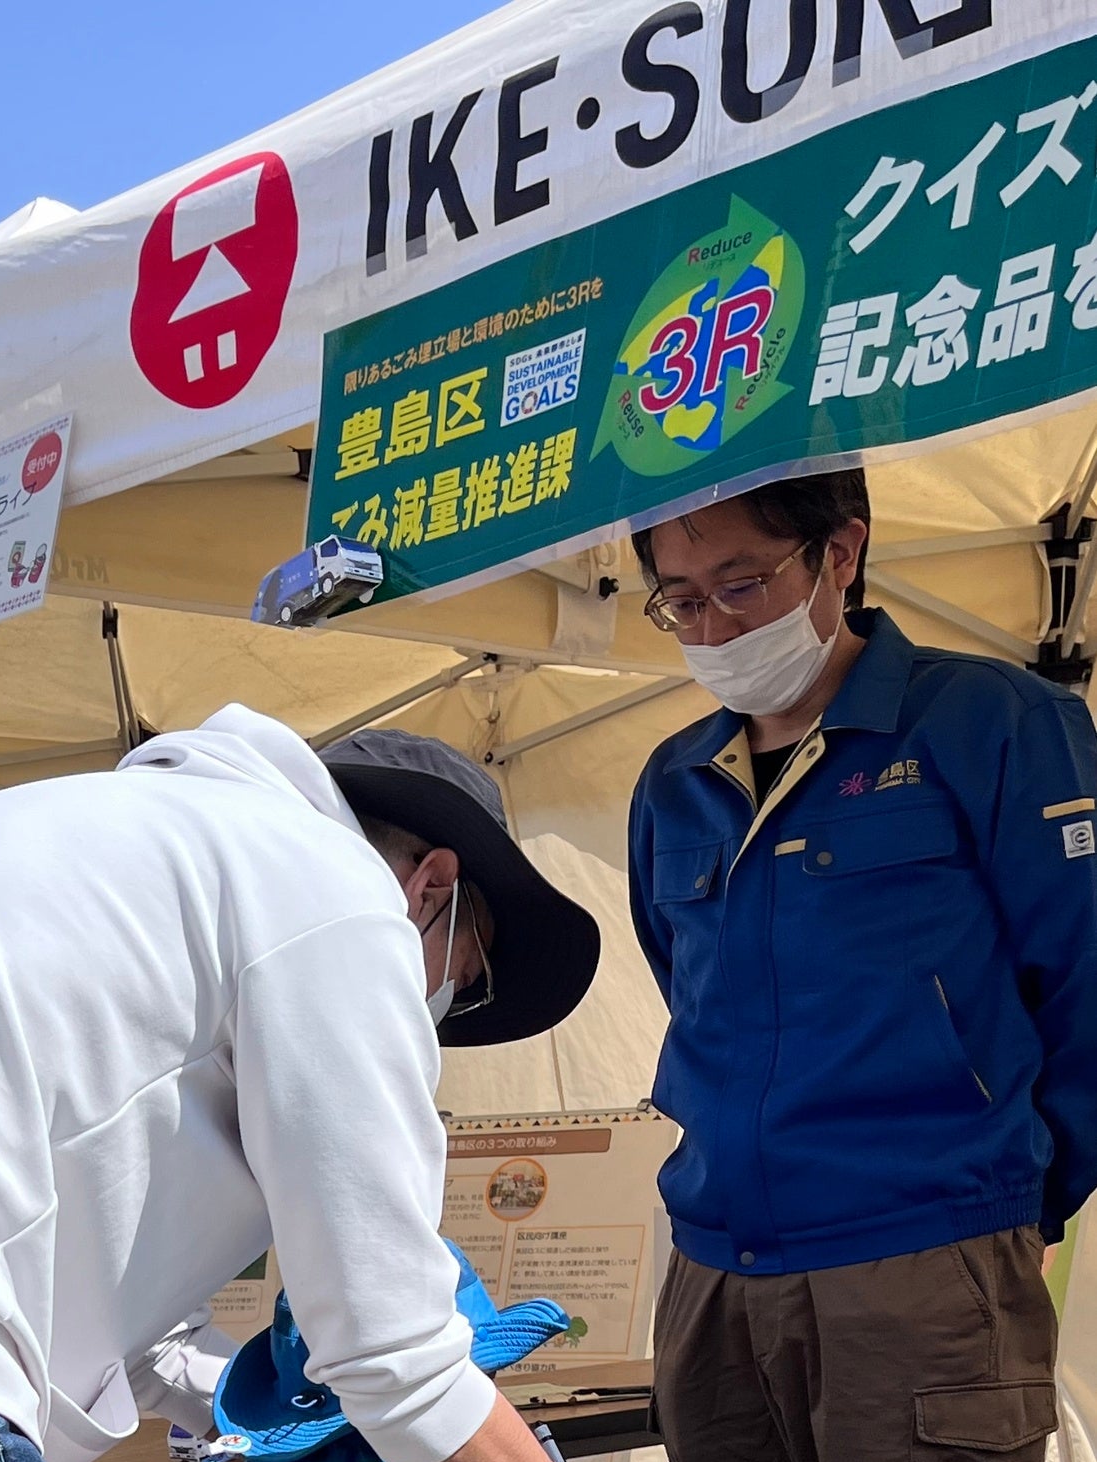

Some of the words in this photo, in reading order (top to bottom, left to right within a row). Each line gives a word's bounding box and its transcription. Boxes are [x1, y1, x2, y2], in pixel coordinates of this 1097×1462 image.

[687, 231, 753, 266] Reduce
[344, 276, 603, 396] 限りあるごみ埋立場と環境のために3Rを
[639, 285, 775, 414] 3R
[507, 360, 579, 396] DEVELOPMENT
[508, 345, 582, 382] SUSTAINABLE
[735, 327, 786, 411] Recycle
[505, 374, 578, 421] GOALS
[618, 389, 645, 438] Reuse
[335, 367, 488, 481] 豊島区
